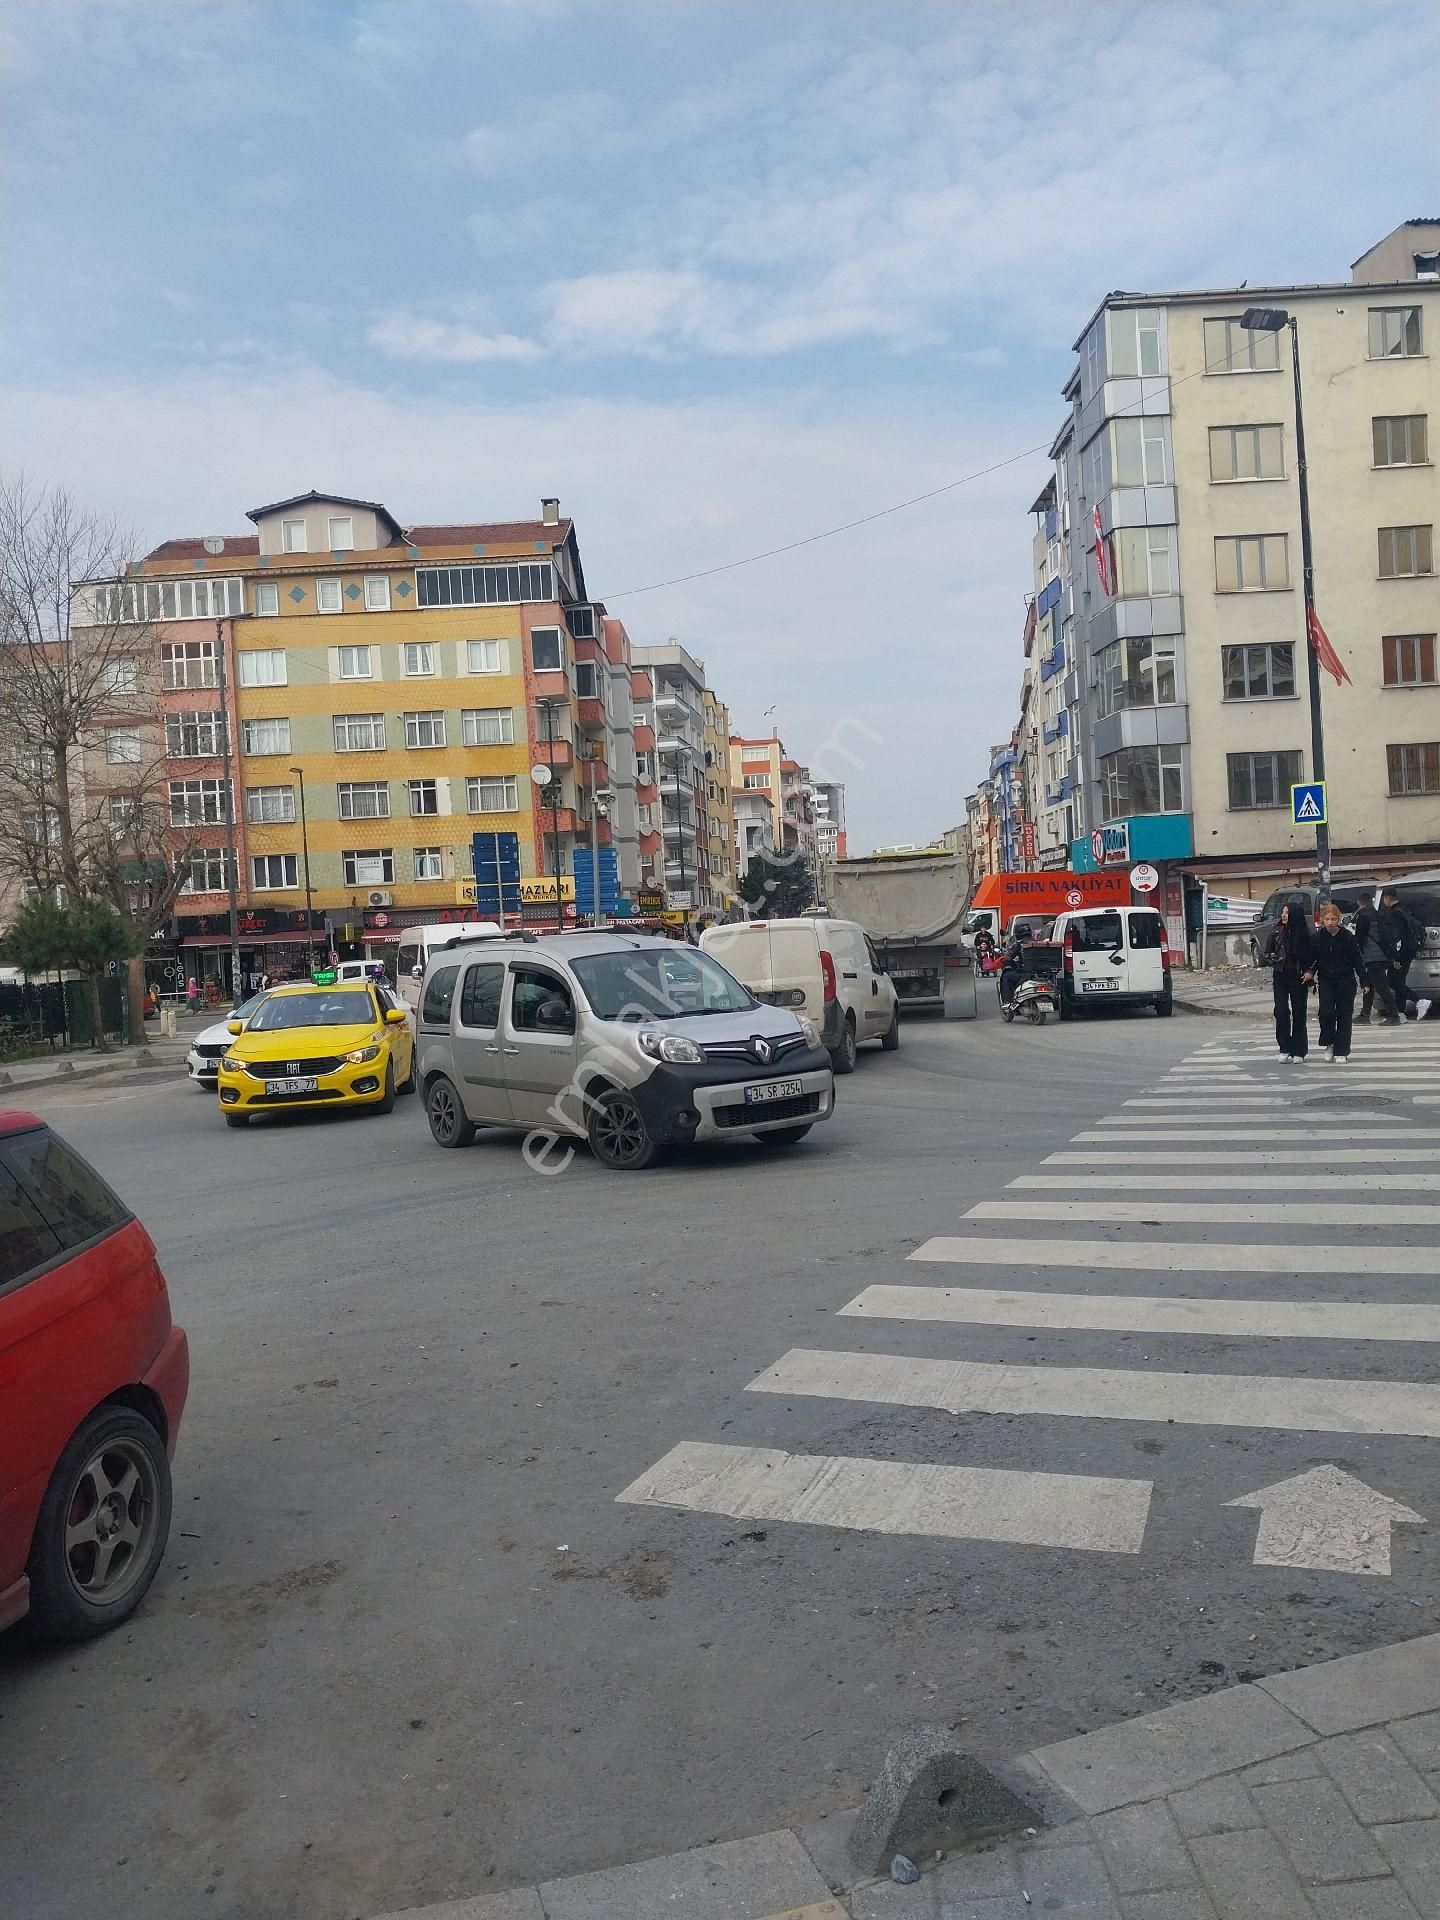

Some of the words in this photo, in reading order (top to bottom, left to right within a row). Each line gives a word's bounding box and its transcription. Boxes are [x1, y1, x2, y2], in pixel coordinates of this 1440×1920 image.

[286, 1063, 301, 1075] FIAT
[270, 1082, 280, 1092] 34
[306, 1080, 315, 1088] 77
[752, 1088, 764, 1101] 34
[767, 1087, 778, 1099] SR
[781, 1084, 801, 1097] 3254
